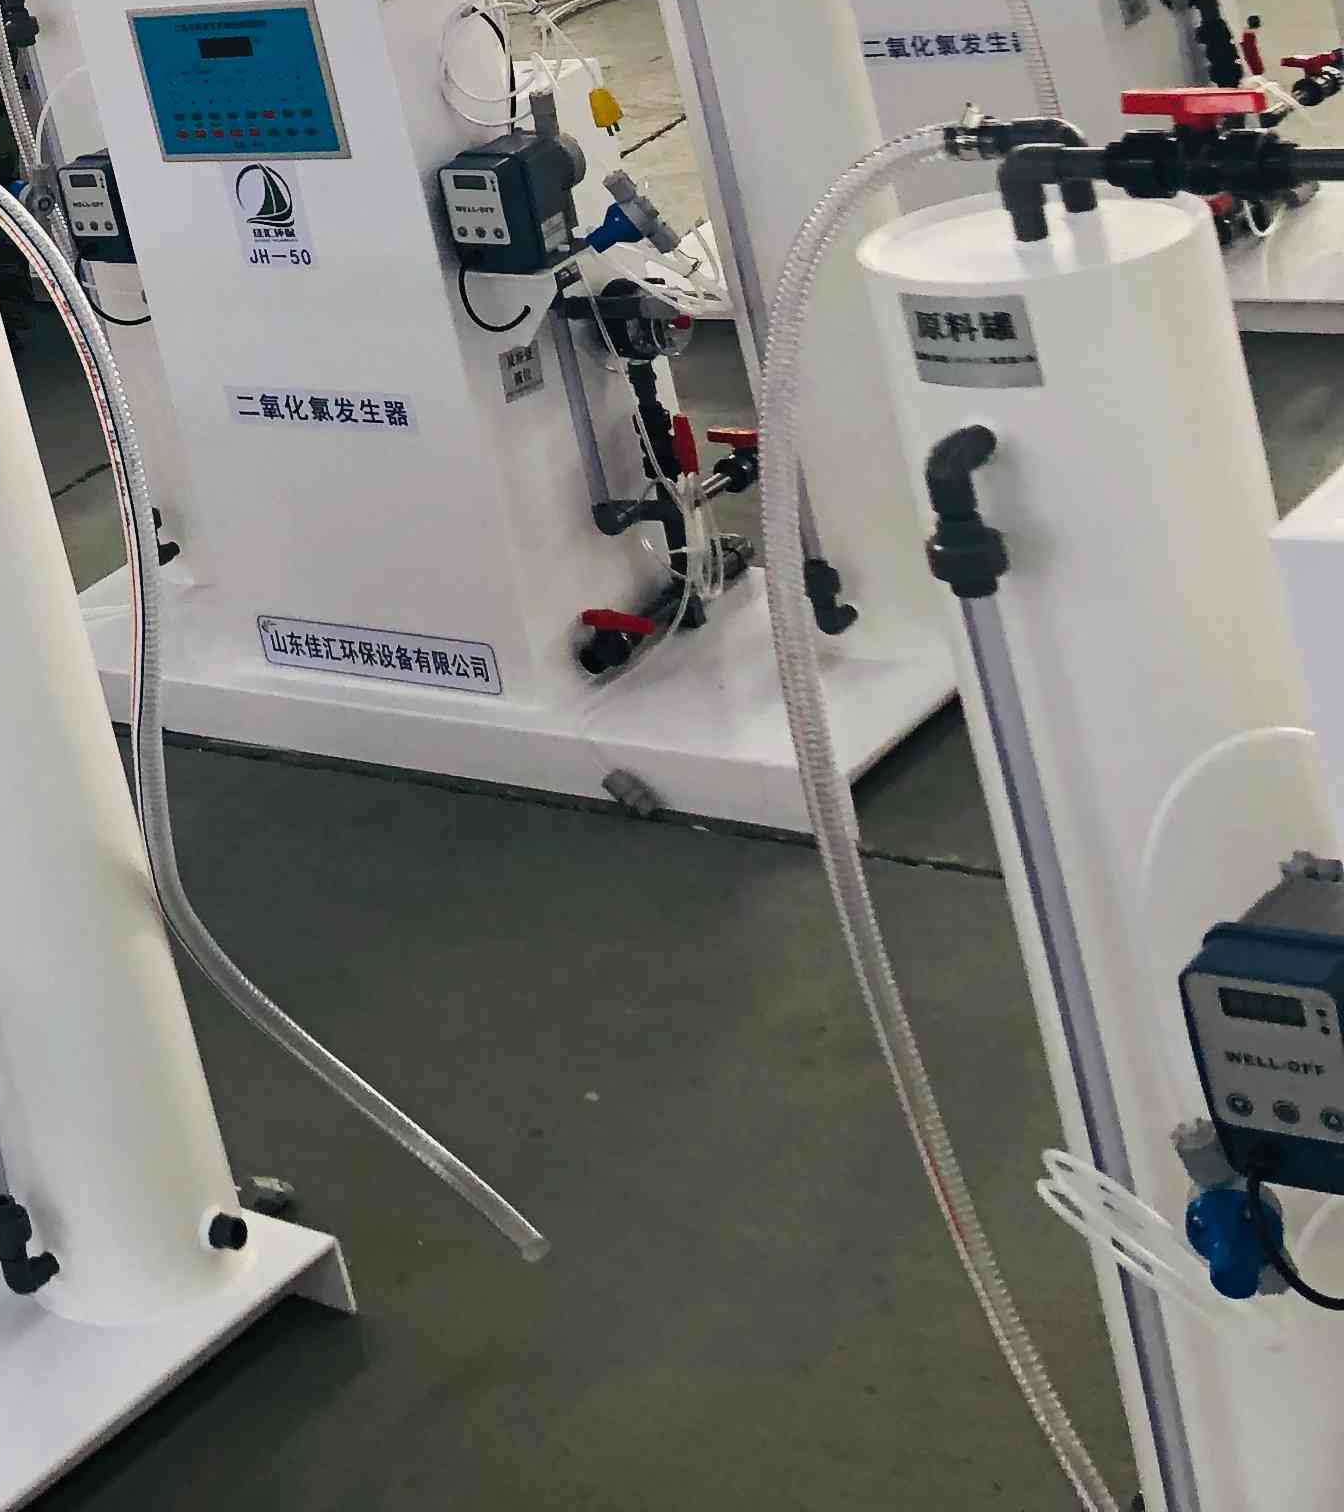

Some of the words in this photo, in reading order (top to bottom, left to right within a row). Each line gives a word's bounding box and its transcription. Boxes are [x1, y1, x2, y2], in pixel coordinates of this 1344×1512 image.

[913, 310, 1018, 343] 原料罐
[236, 393, 409, 426] 二氧化氯发生器
[269, 629, 491, 683] 山东佳汇环保设备有限公司
